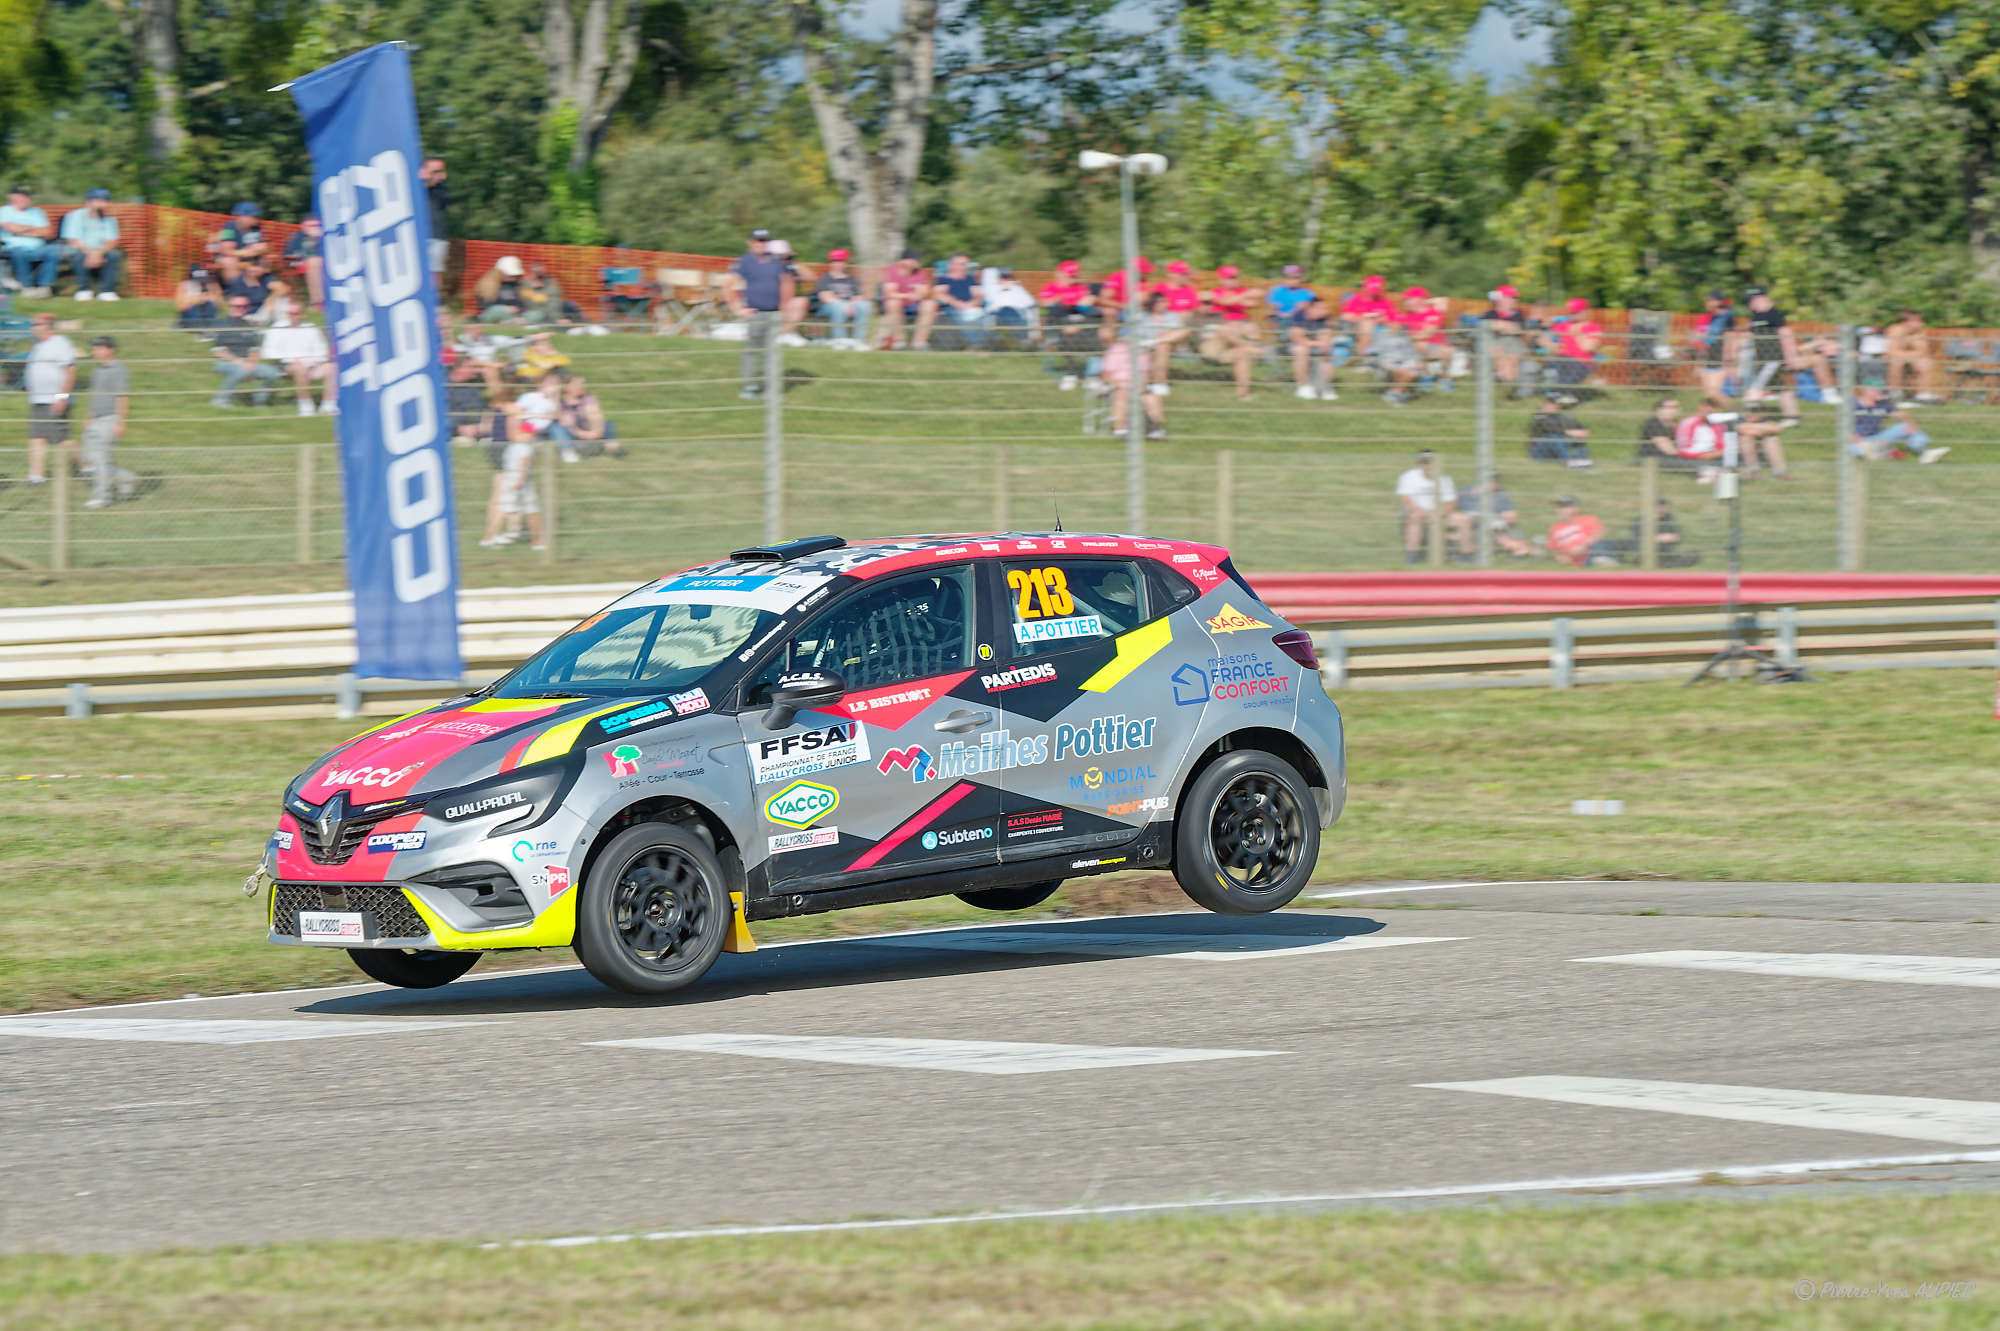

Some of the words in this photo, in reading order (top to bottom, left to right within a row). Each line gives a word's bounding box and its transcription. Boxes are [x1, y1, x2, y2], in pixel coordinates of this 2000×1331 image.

[685, 579, 744, 588] POTTIER
[1007, 567, 1075, 619] 213
[1020, 619, 1099, 641] A.POTTIER
[1208, 616, 1258, 630] SAGIR
[1208, 652, 1258, 667] maisons
[980, 663, 1056, 689] PARTEDIS
[1211, 661, 1275, 683] FRANCE
[1214, 677, 1289, 700] CONFORT
[599, 701, 670, 728] SOPREMA
[849, 701, 868, 713] LE
[761, 725, 848, 760] FFSA
[937, 730, 1048, 780] Mailhes
[1054, 715, 1156, 762] Pottier
[760, 763, 823, 782] RALLYCROSS
[826, 755, 857, 769] JUNIOR
[761, 757, 814, 773] CHAMPIONNAT
[816, 753, 826, 761] DE
[828, 747, 857, 759] FRANCE
[321, 766, 406, 788] YACCO
[648, 773, 668, 784] Cour
[1069, 764, 1157, 790] MONDIAL
[445, 791, 526, 819] QUALI-PROFIL
[775, 793, 830, 815] YACCO
[368, 832, 426, 847] COOPER
[774, 833, 814, 848] RALLYCROSS
[938, 827, 993, 846] Subteno
